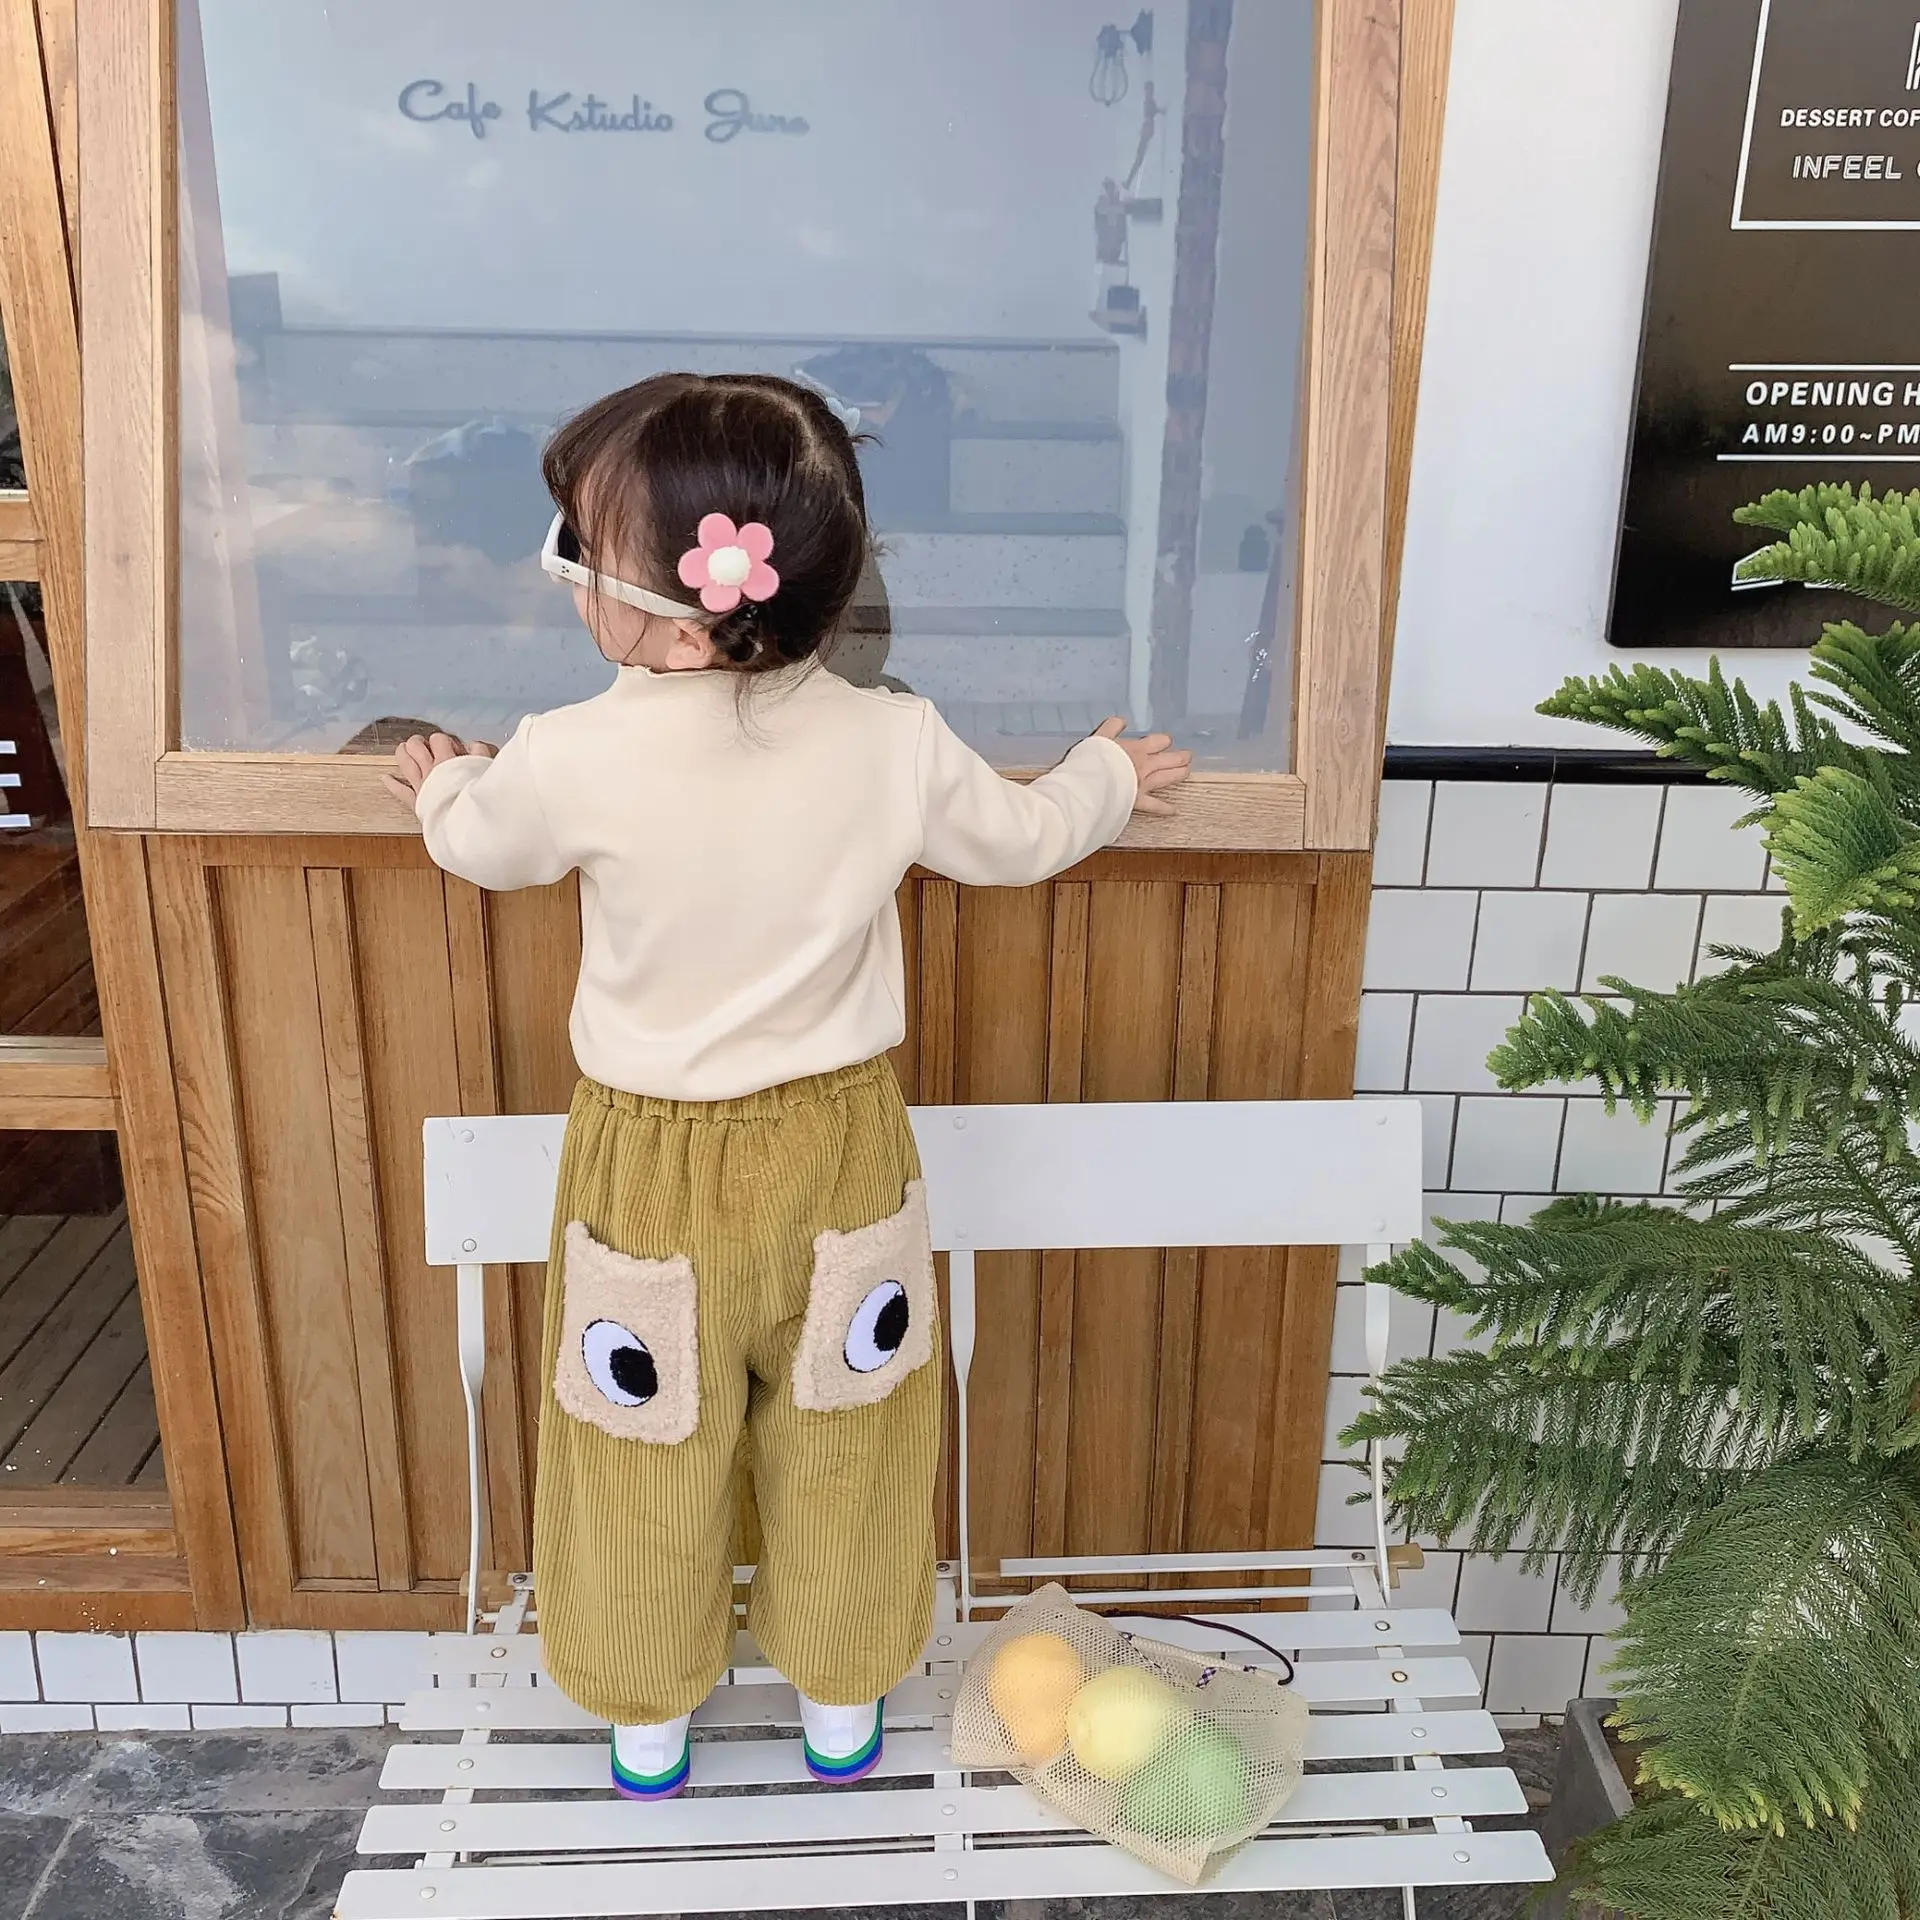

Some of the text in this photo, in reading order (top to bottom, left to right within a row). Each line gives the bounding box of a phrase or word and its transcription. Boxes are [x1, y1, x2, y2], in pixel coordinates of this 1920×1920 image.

[398, 79, 502, 140] Cafe
[526, 89, 674, 133] Kstudio
[1780, 108, 1877, 127] DESSERT
[1792, 155, 1902, 180] INFEEL
[1746, 381, 1894, 406] OPENING
